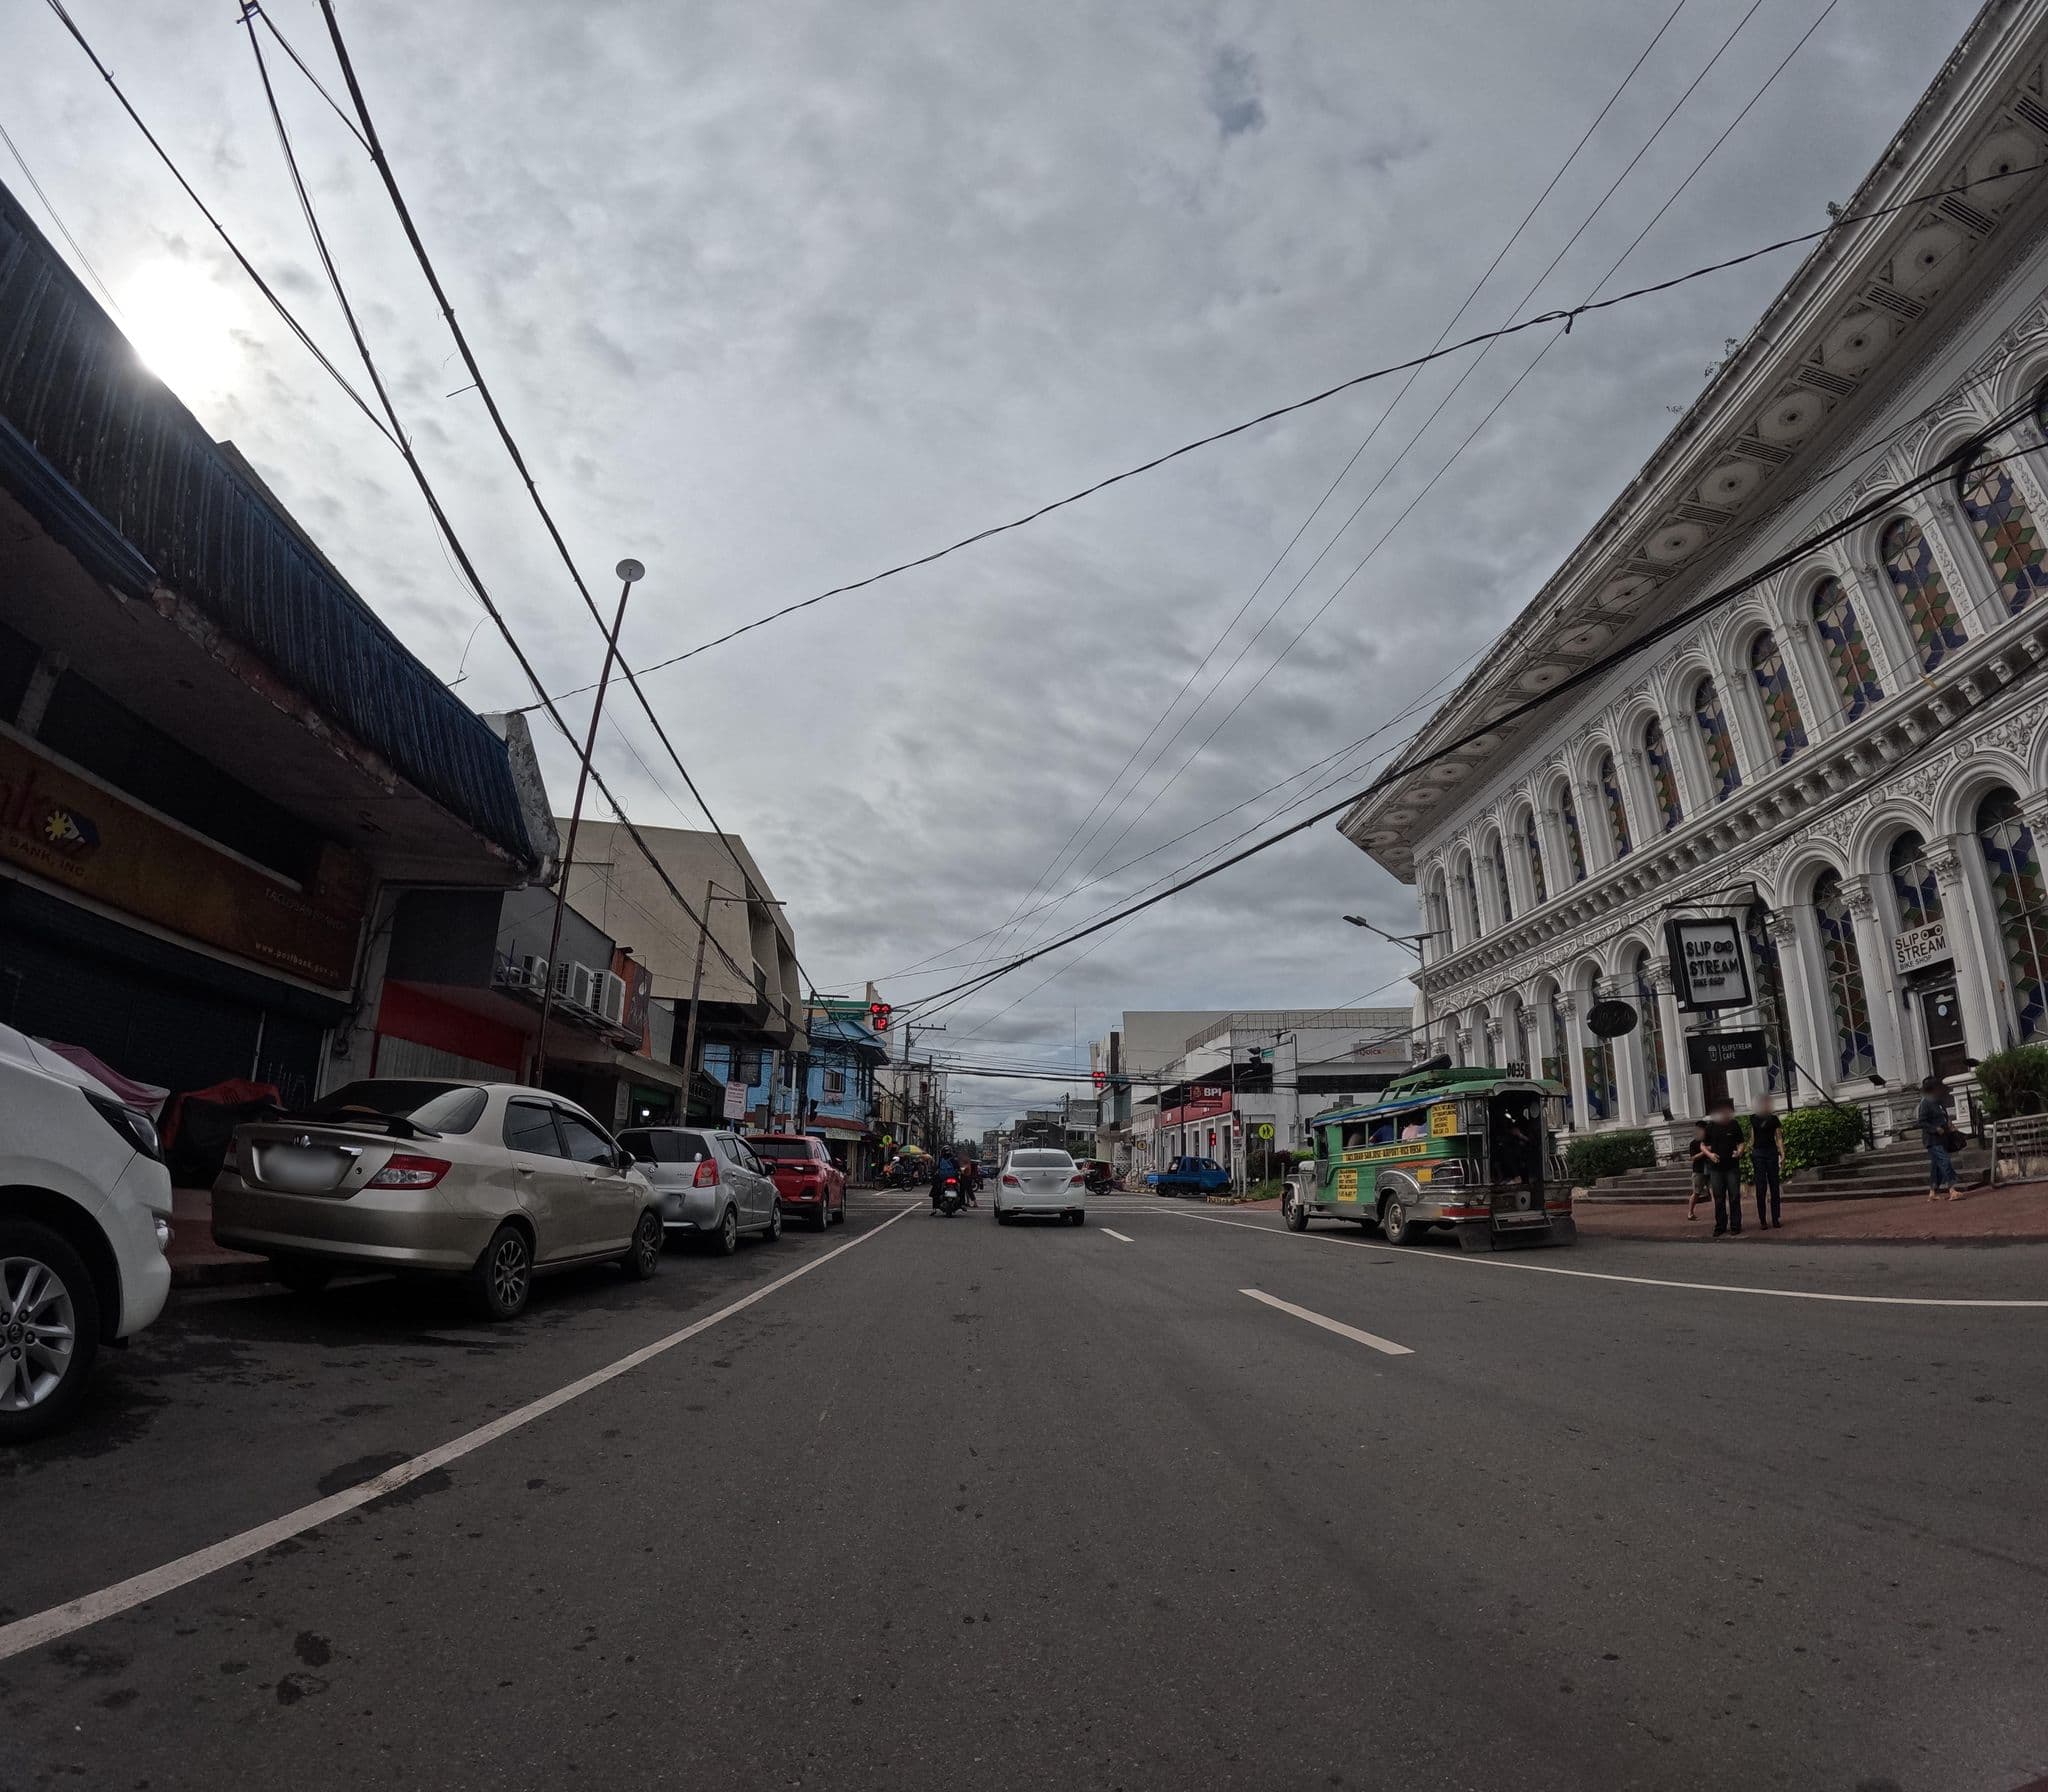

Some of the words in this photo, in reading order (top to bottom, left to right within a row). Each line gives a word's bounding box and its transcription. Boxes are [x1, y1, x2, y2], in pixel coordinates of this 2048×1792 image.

[1686, 941, 1711, 957] SLIP
[1895, 933, 1918, 951] SLIP
[1898, 935, 1946, 963] STREAM
[1690, 958, 1739, 976] STREAM
[1507, 1062, 1525, 1078] 0035
[1203, 1087, 1222, 1097] BPI
